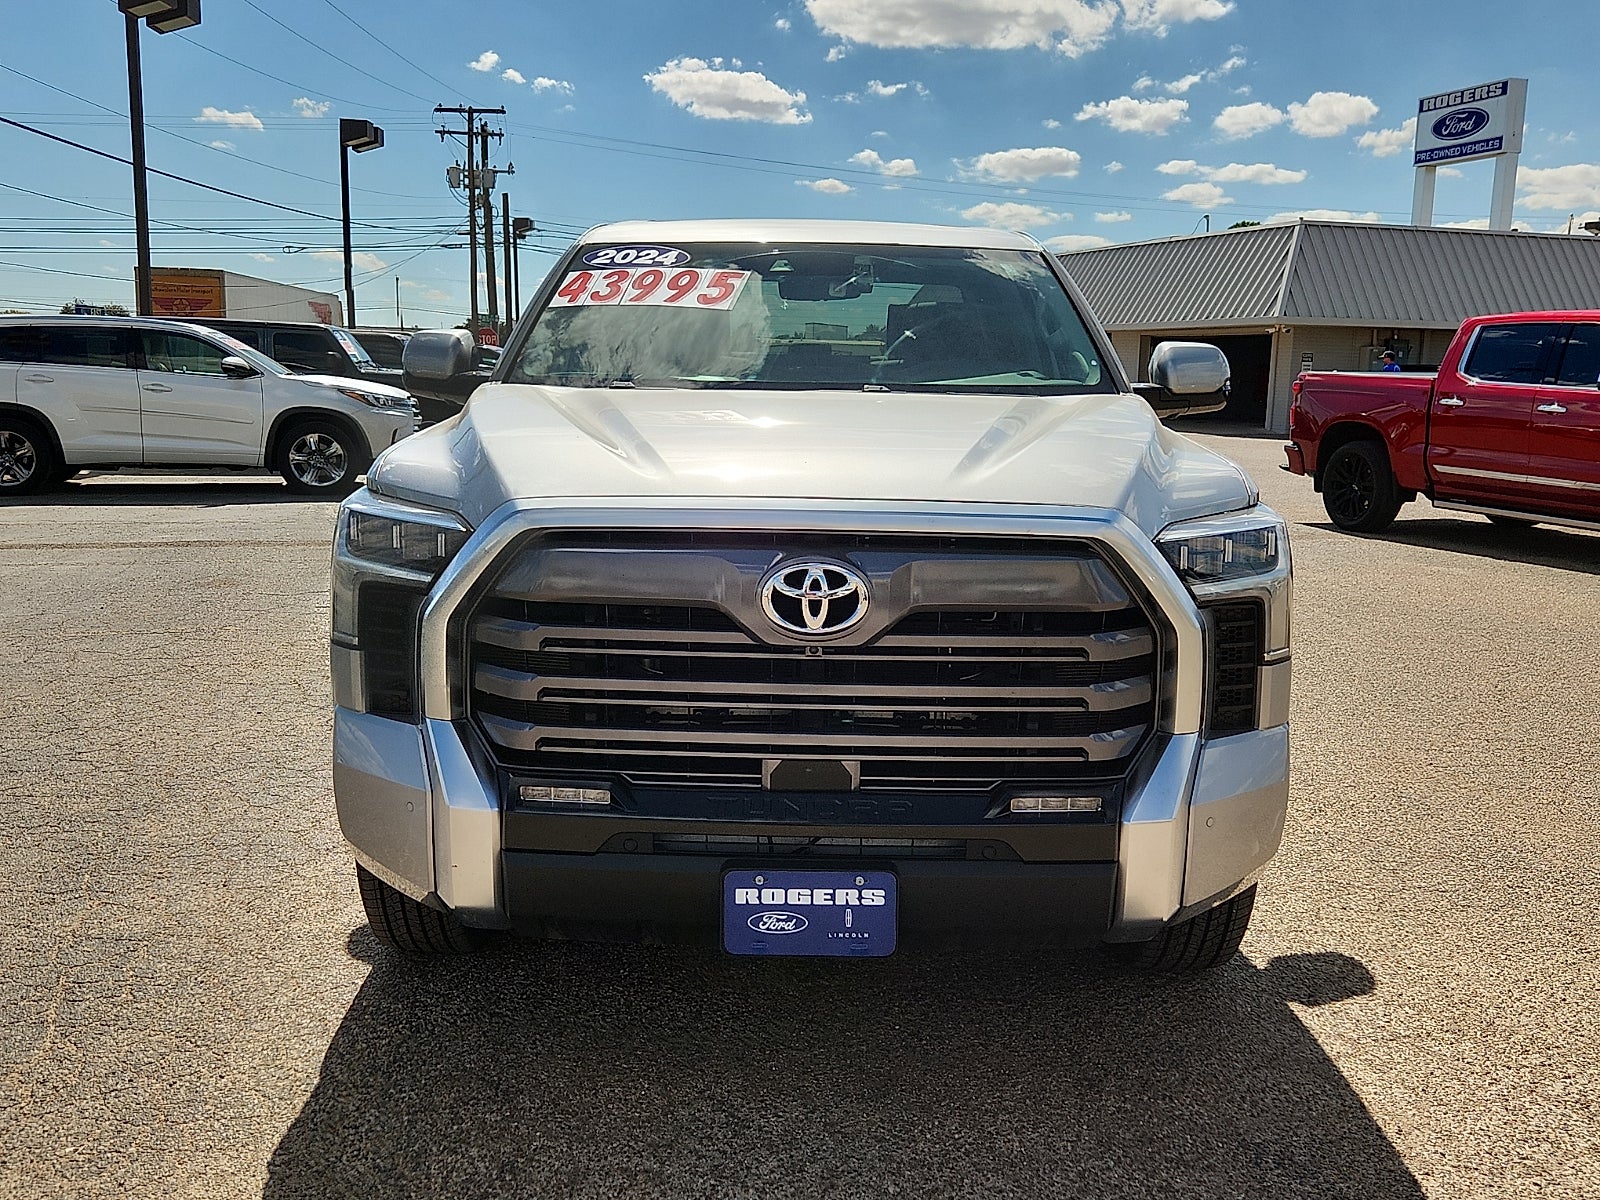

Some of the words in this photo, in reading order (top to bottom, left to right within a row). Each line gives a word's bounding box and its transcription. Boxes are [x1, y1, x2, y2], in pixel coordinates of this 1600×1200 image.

[1422, 83, 1503, 112] ROGERS
[1441, 112, 1477, 136] Ford
[1416, 145, 1461, 162] PRE-OWNED
[1461, 139, 1500, 154] VEHICLES
[591, 249, 678, 266] 2024
[557, 269, 746, 305] 43995
[735, 888, 886, 906] ROGERS
[758, 914, 797, 931] Ford
